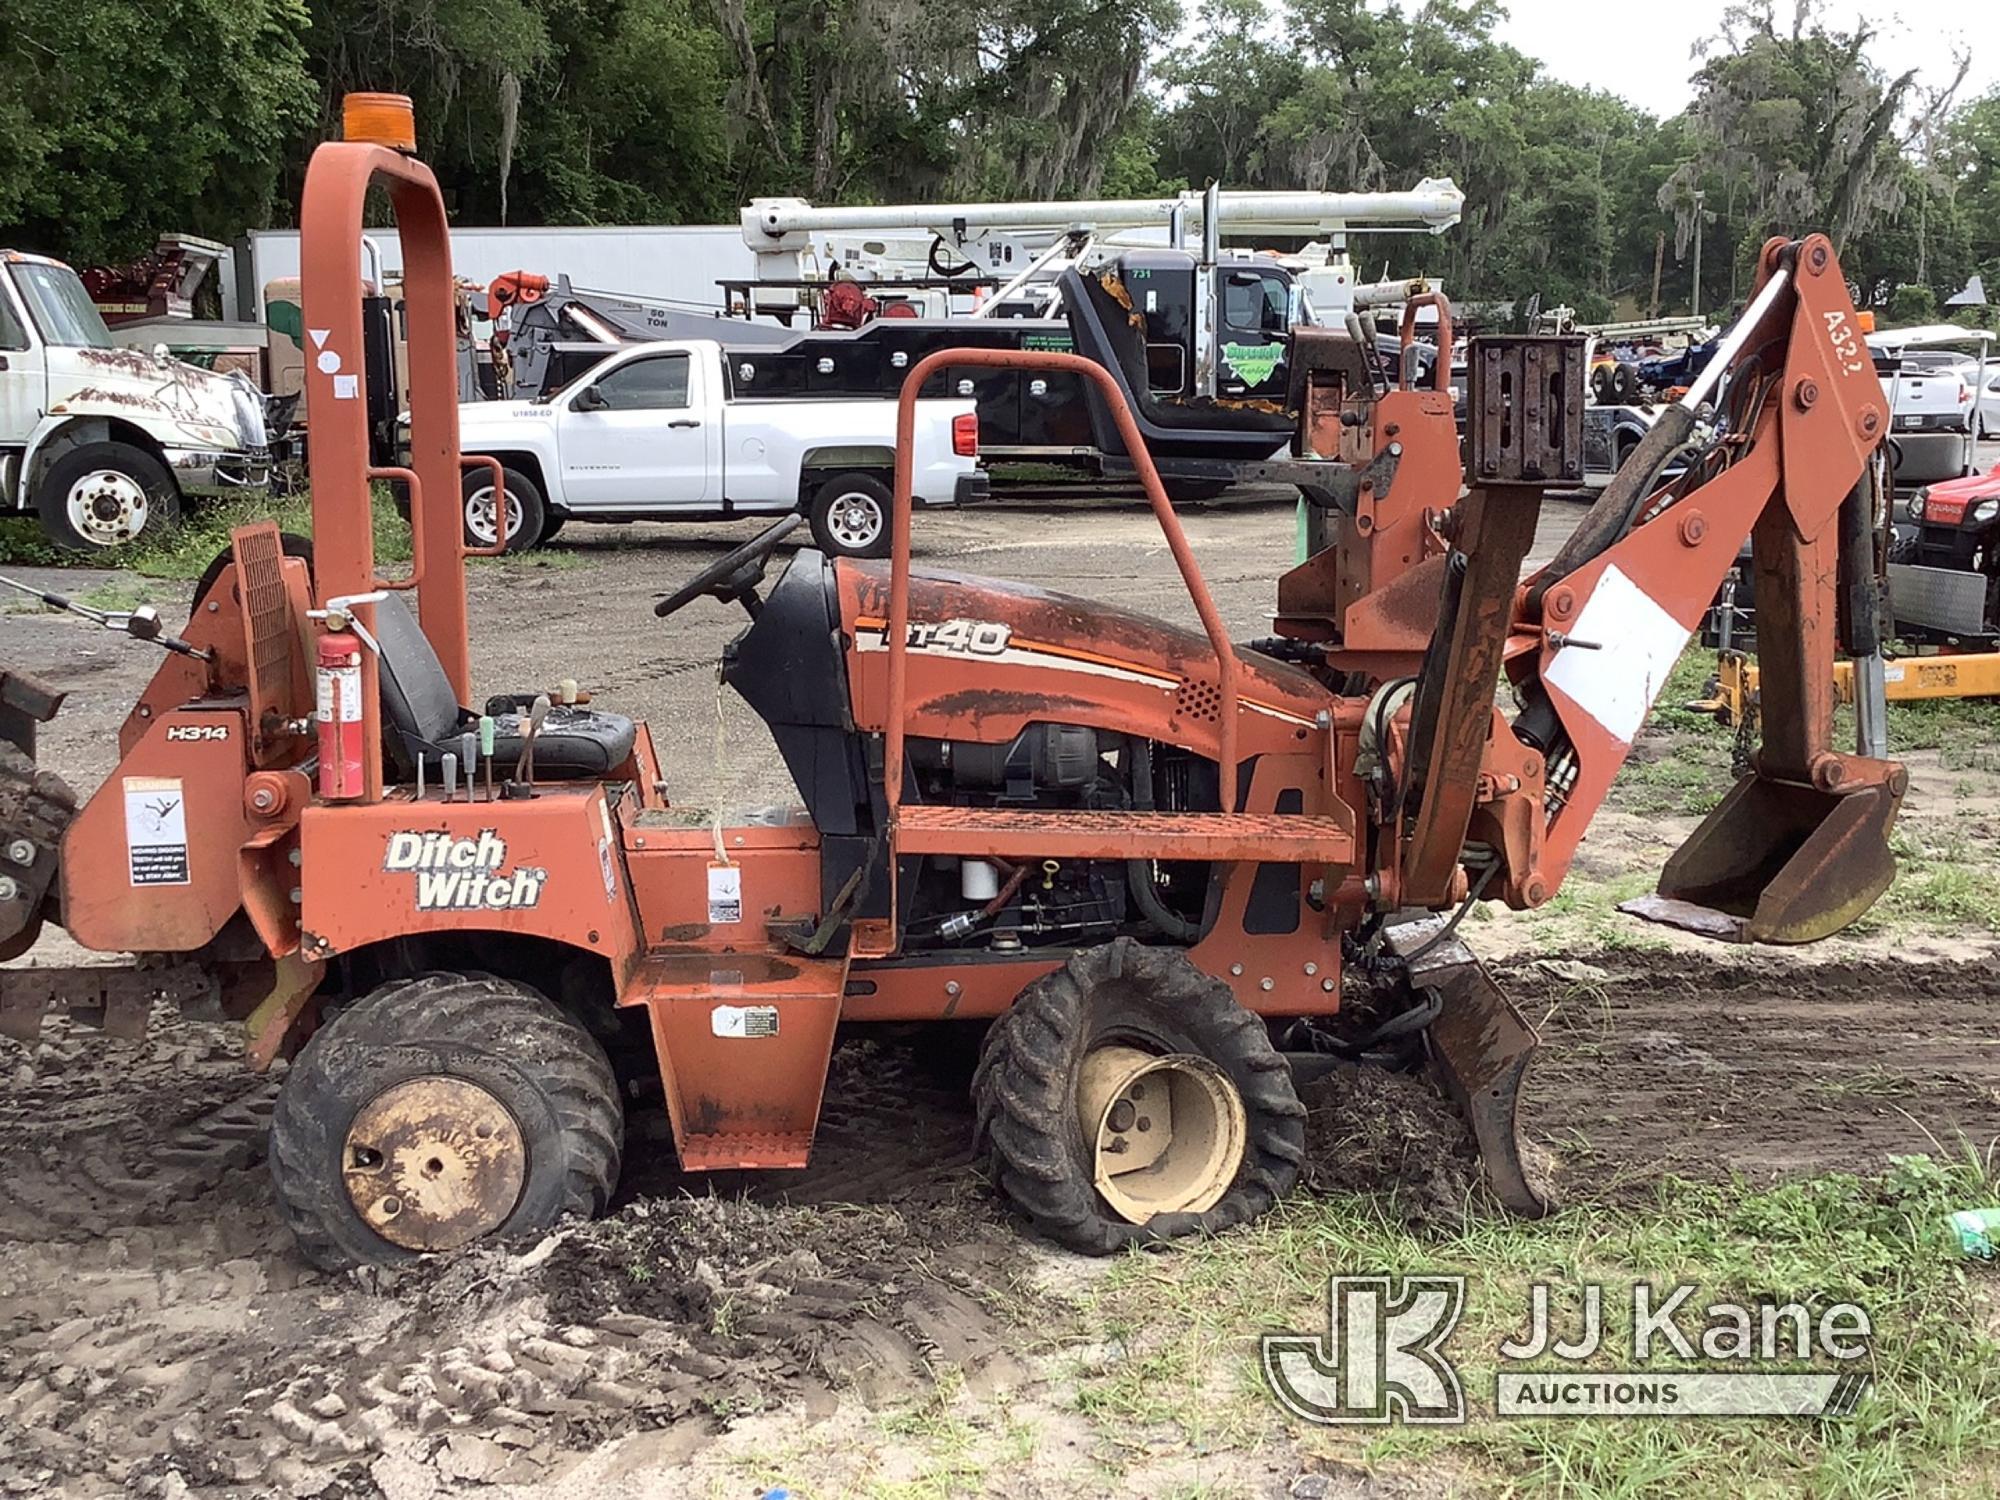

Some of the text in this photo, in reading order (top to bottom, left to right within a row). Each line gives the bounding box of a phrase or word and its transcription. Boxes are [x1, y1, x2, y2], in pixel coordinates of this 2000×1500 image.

[1132, 270, 1151, 279] 731
[650, 309, 665, 318] 50
[647, 318, 668, 328] TON
[1823, 311, 1863, 377] A322
[167, 726, 228, 740] H314
[386, 831, 505, 868] Ditch
[418, 870, 540, 907] Witch
